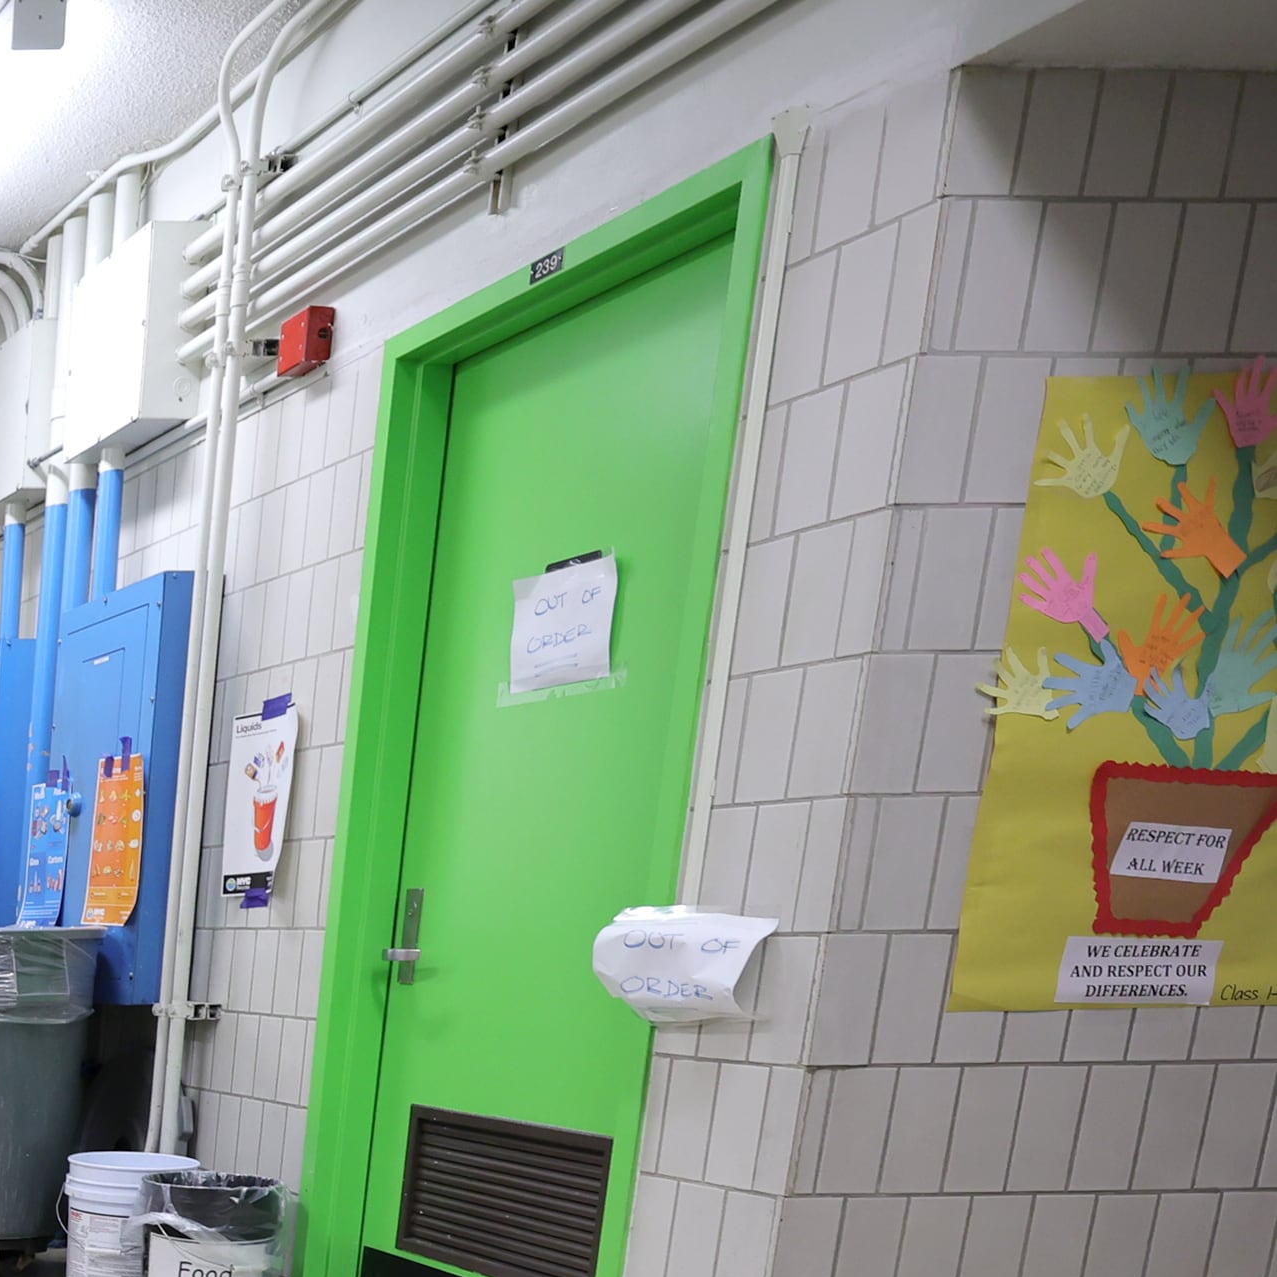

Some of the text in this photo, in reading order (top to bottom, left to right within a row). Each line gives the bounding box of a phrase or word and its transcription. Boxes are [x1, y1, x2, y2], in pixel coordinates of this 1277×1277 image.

[535, 254, 558, 279] 239
[534, 586, 602, 616] OUT OF
[526, 623, 593, 654] ORDER
[236, 722, 263, 735] Liquids
[1126, 828, 1227, 849] RESPECT FOR
[1126, 857, 1205, 876] ALL WEEK
[623, 929, 741, 955] OUT OF
[1086, 944, 1202, 958] WE CELEBRATE
[1069, 964, 1207, 978] AND RESPECT OUR
[620, 975, 714, 1001] ORDER
[1084, 984, 1189, 998] DIFFERENCES.
[1220, 984, 1259, 1001] Class
